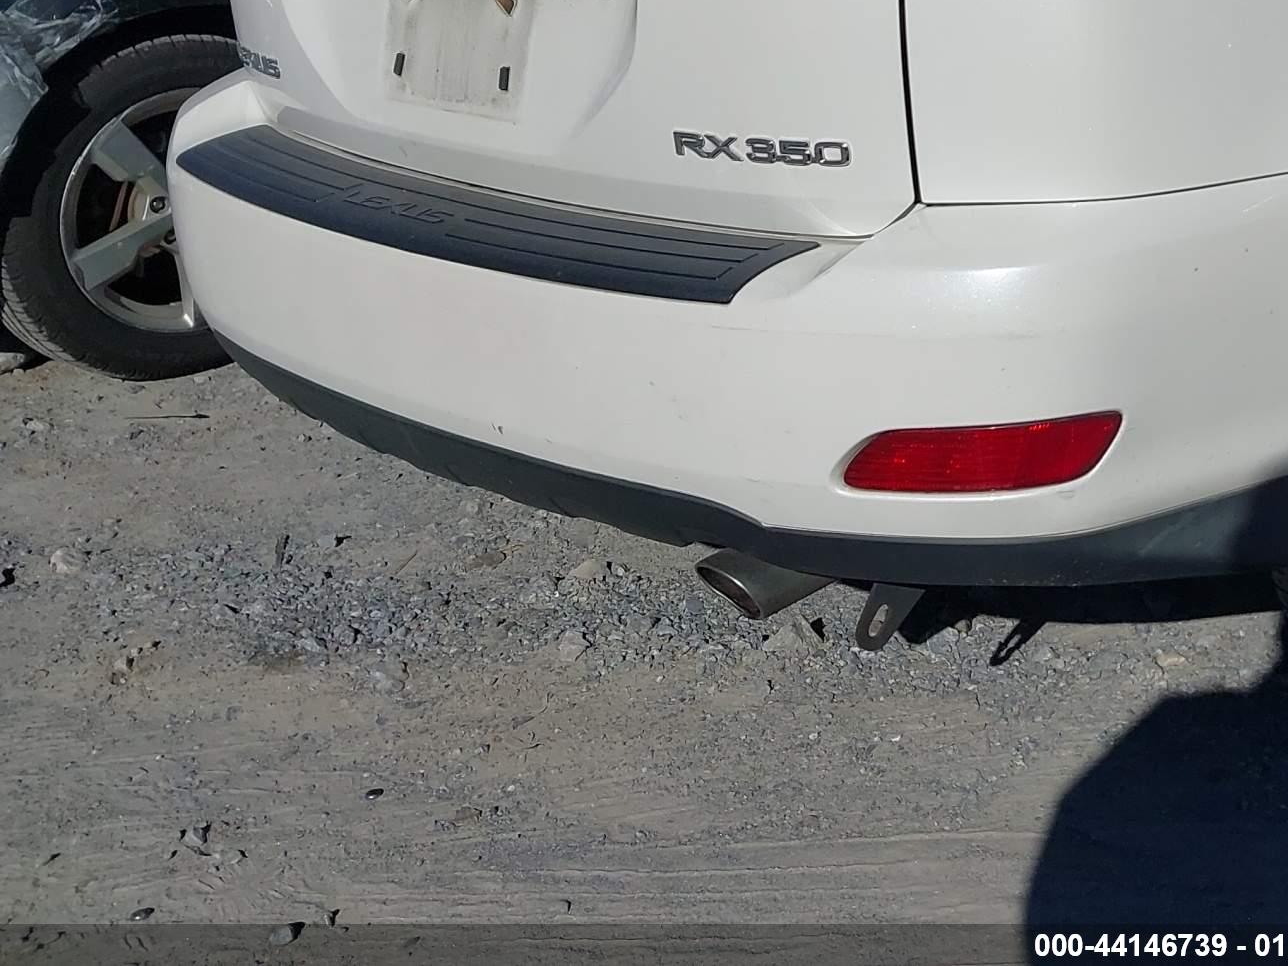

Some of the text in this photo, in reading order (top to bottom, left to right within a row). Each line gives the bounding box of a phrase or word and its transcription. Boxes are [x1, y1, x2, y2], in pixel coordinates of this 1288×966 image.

[673, 131, 851, 168] RX 350
[343, 183, 454, 224] LEXUS
